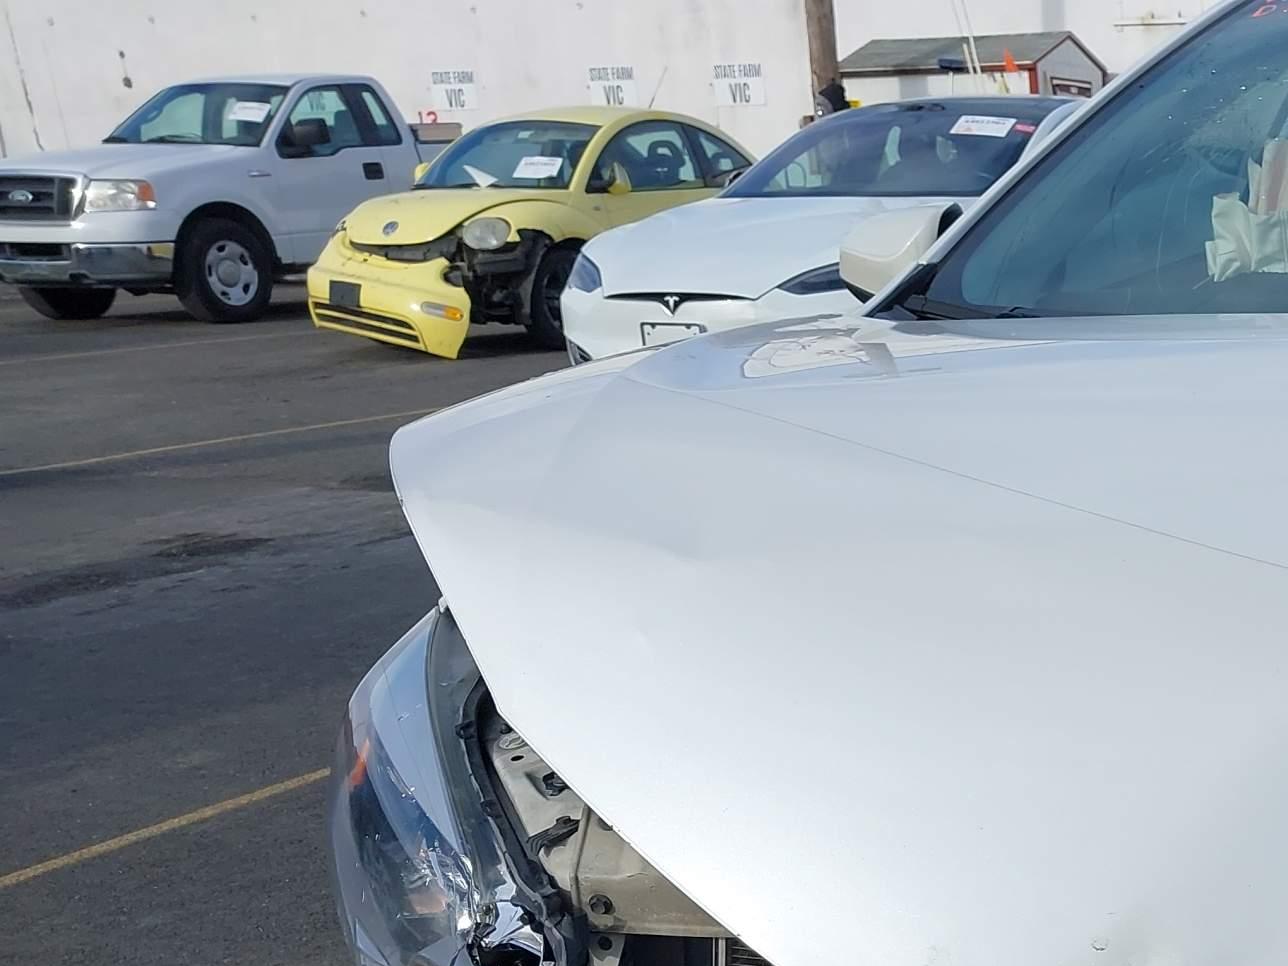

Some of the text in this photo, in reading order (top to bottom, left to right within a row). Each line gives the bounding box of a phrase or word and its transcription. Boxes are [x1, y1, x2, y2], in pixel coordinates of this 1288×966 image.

[432, 70, 473, 84] STATE FARM
[590, 66, 633, 81] STATE FARM
[713, 63, 761, 79] STATE FARM
[445, 88, 465, 107] VIC
[603, 84, 624, 105] VIC
[729, 82, 750, 103] VIC
